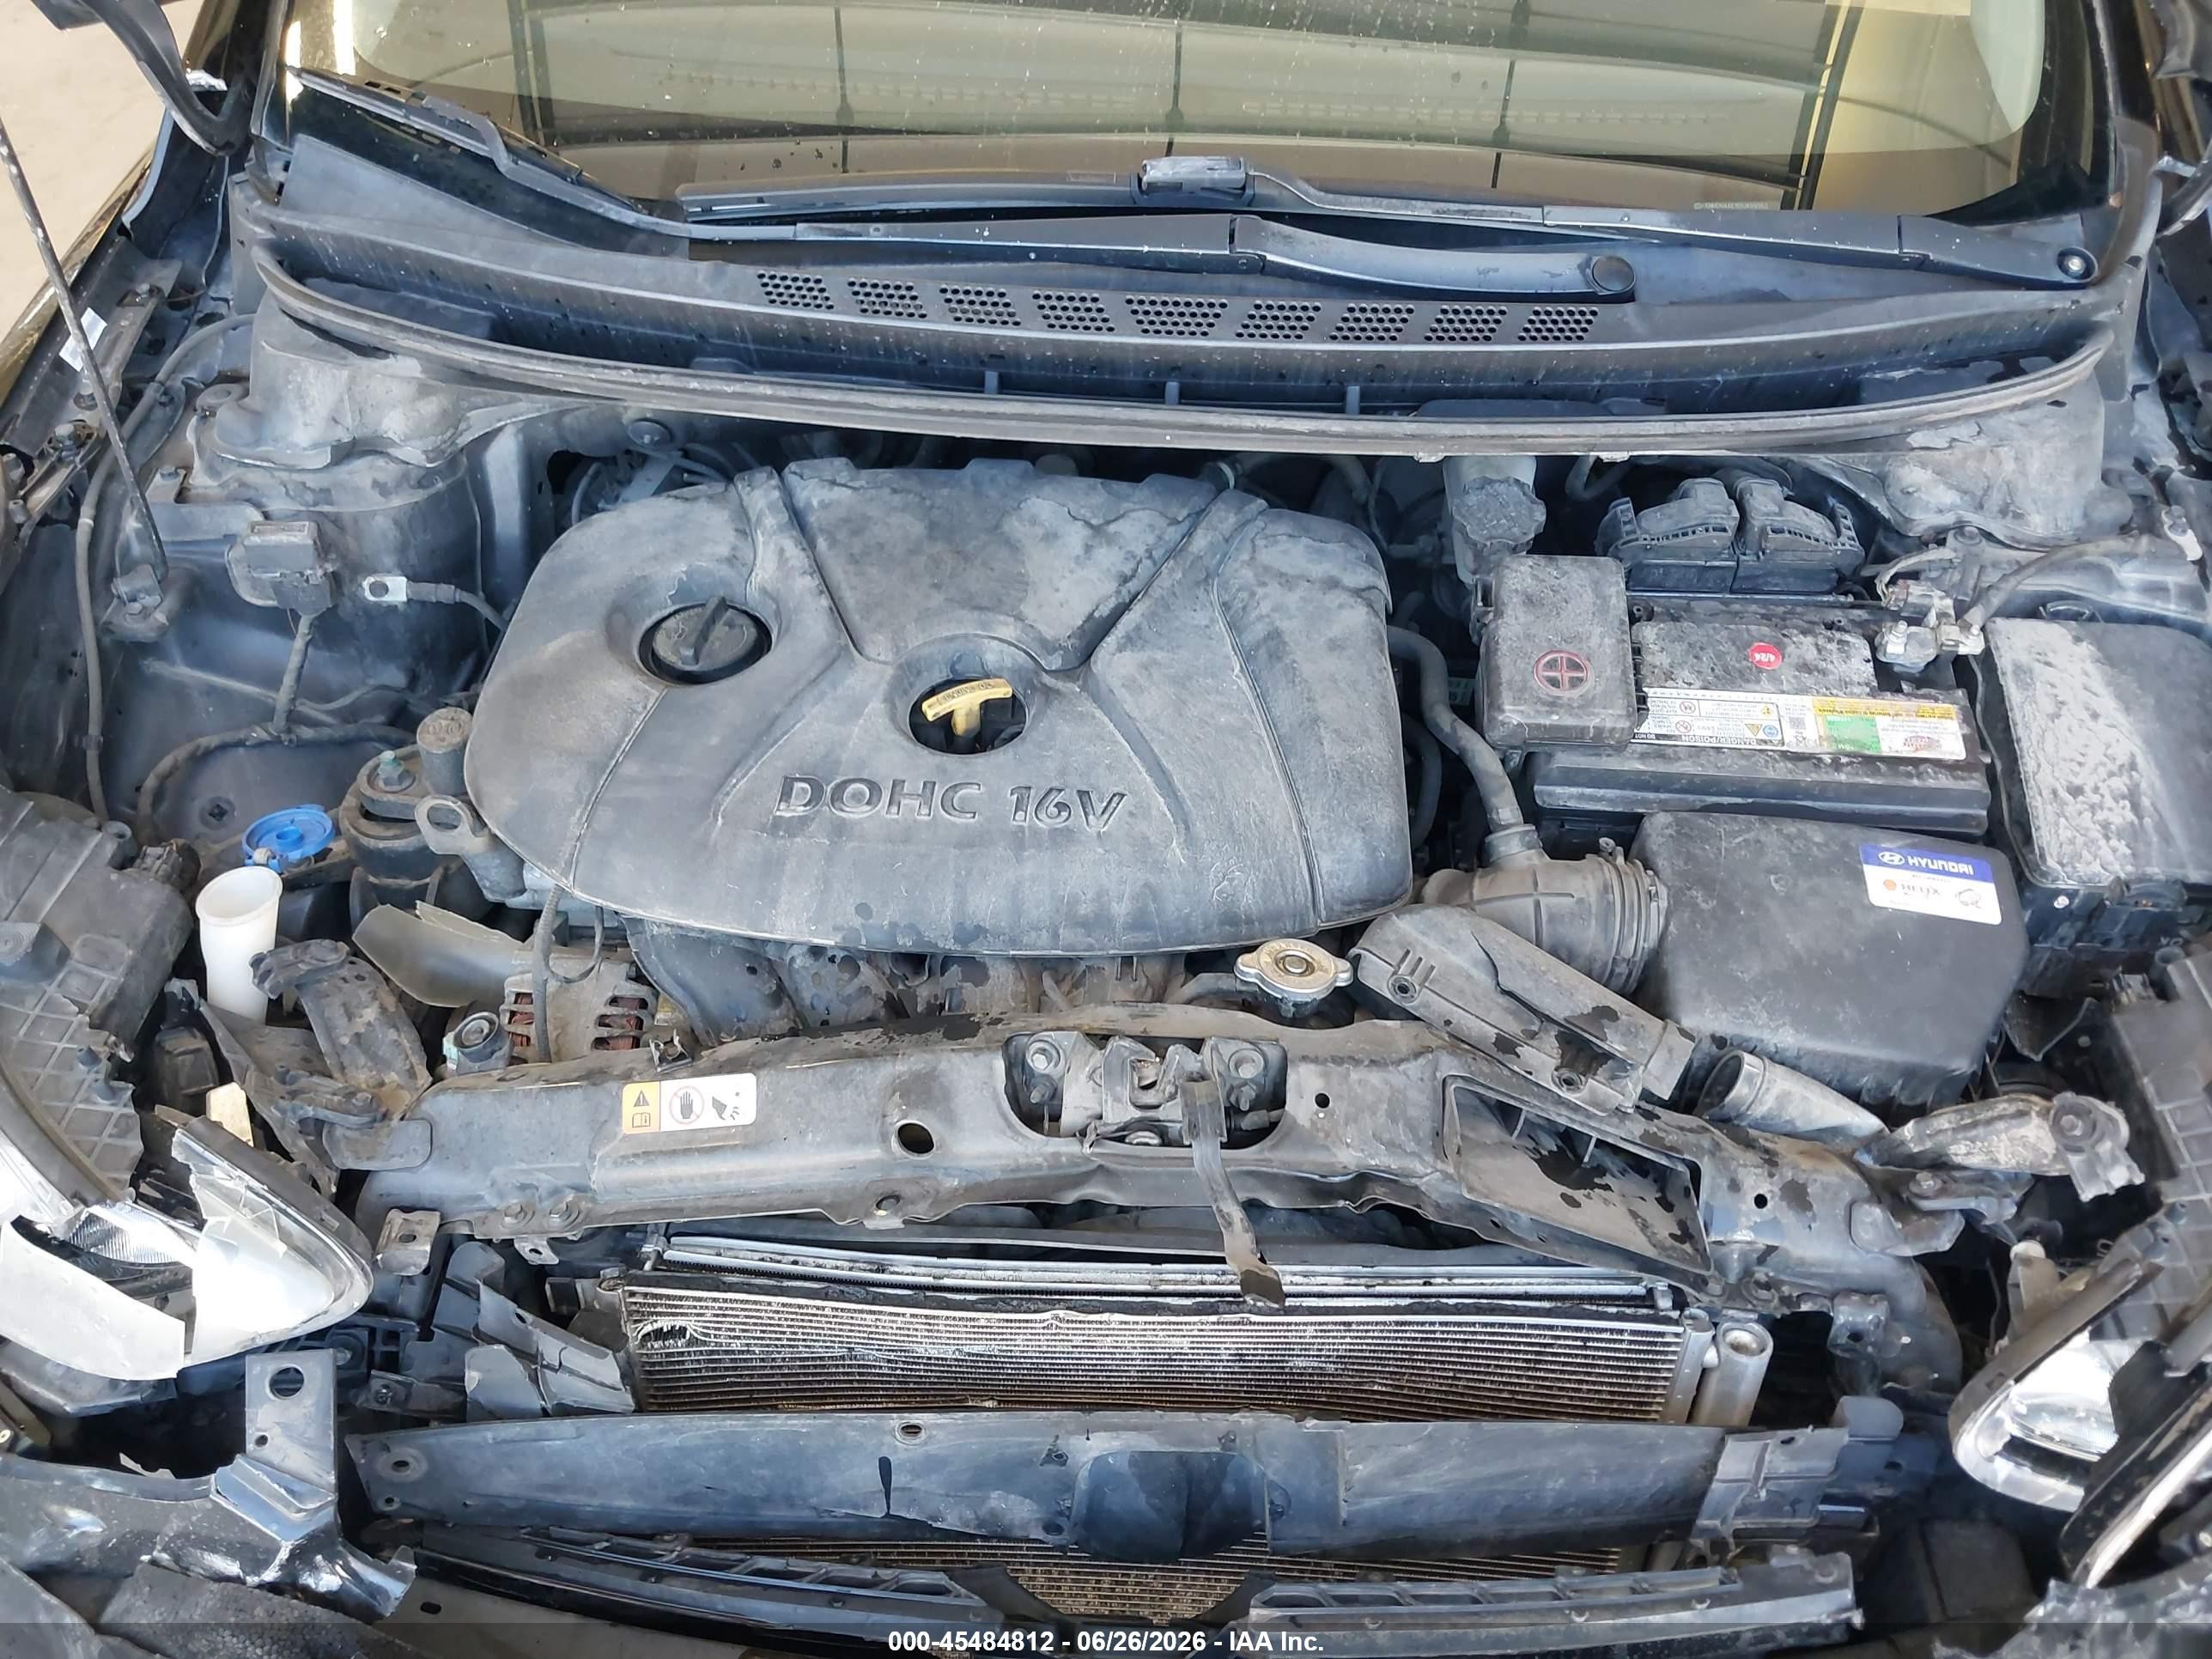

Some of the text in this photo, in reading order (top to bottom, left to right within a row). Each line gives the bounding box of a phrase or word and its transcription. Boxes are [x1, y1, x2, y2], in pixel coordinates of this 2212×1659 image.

[1681, 735, 1757, 746] DANGER/POISON
[775, 775, 1127, 831] DOHC 16V
[1907, 856, 1974, 875] HYUNDAI
